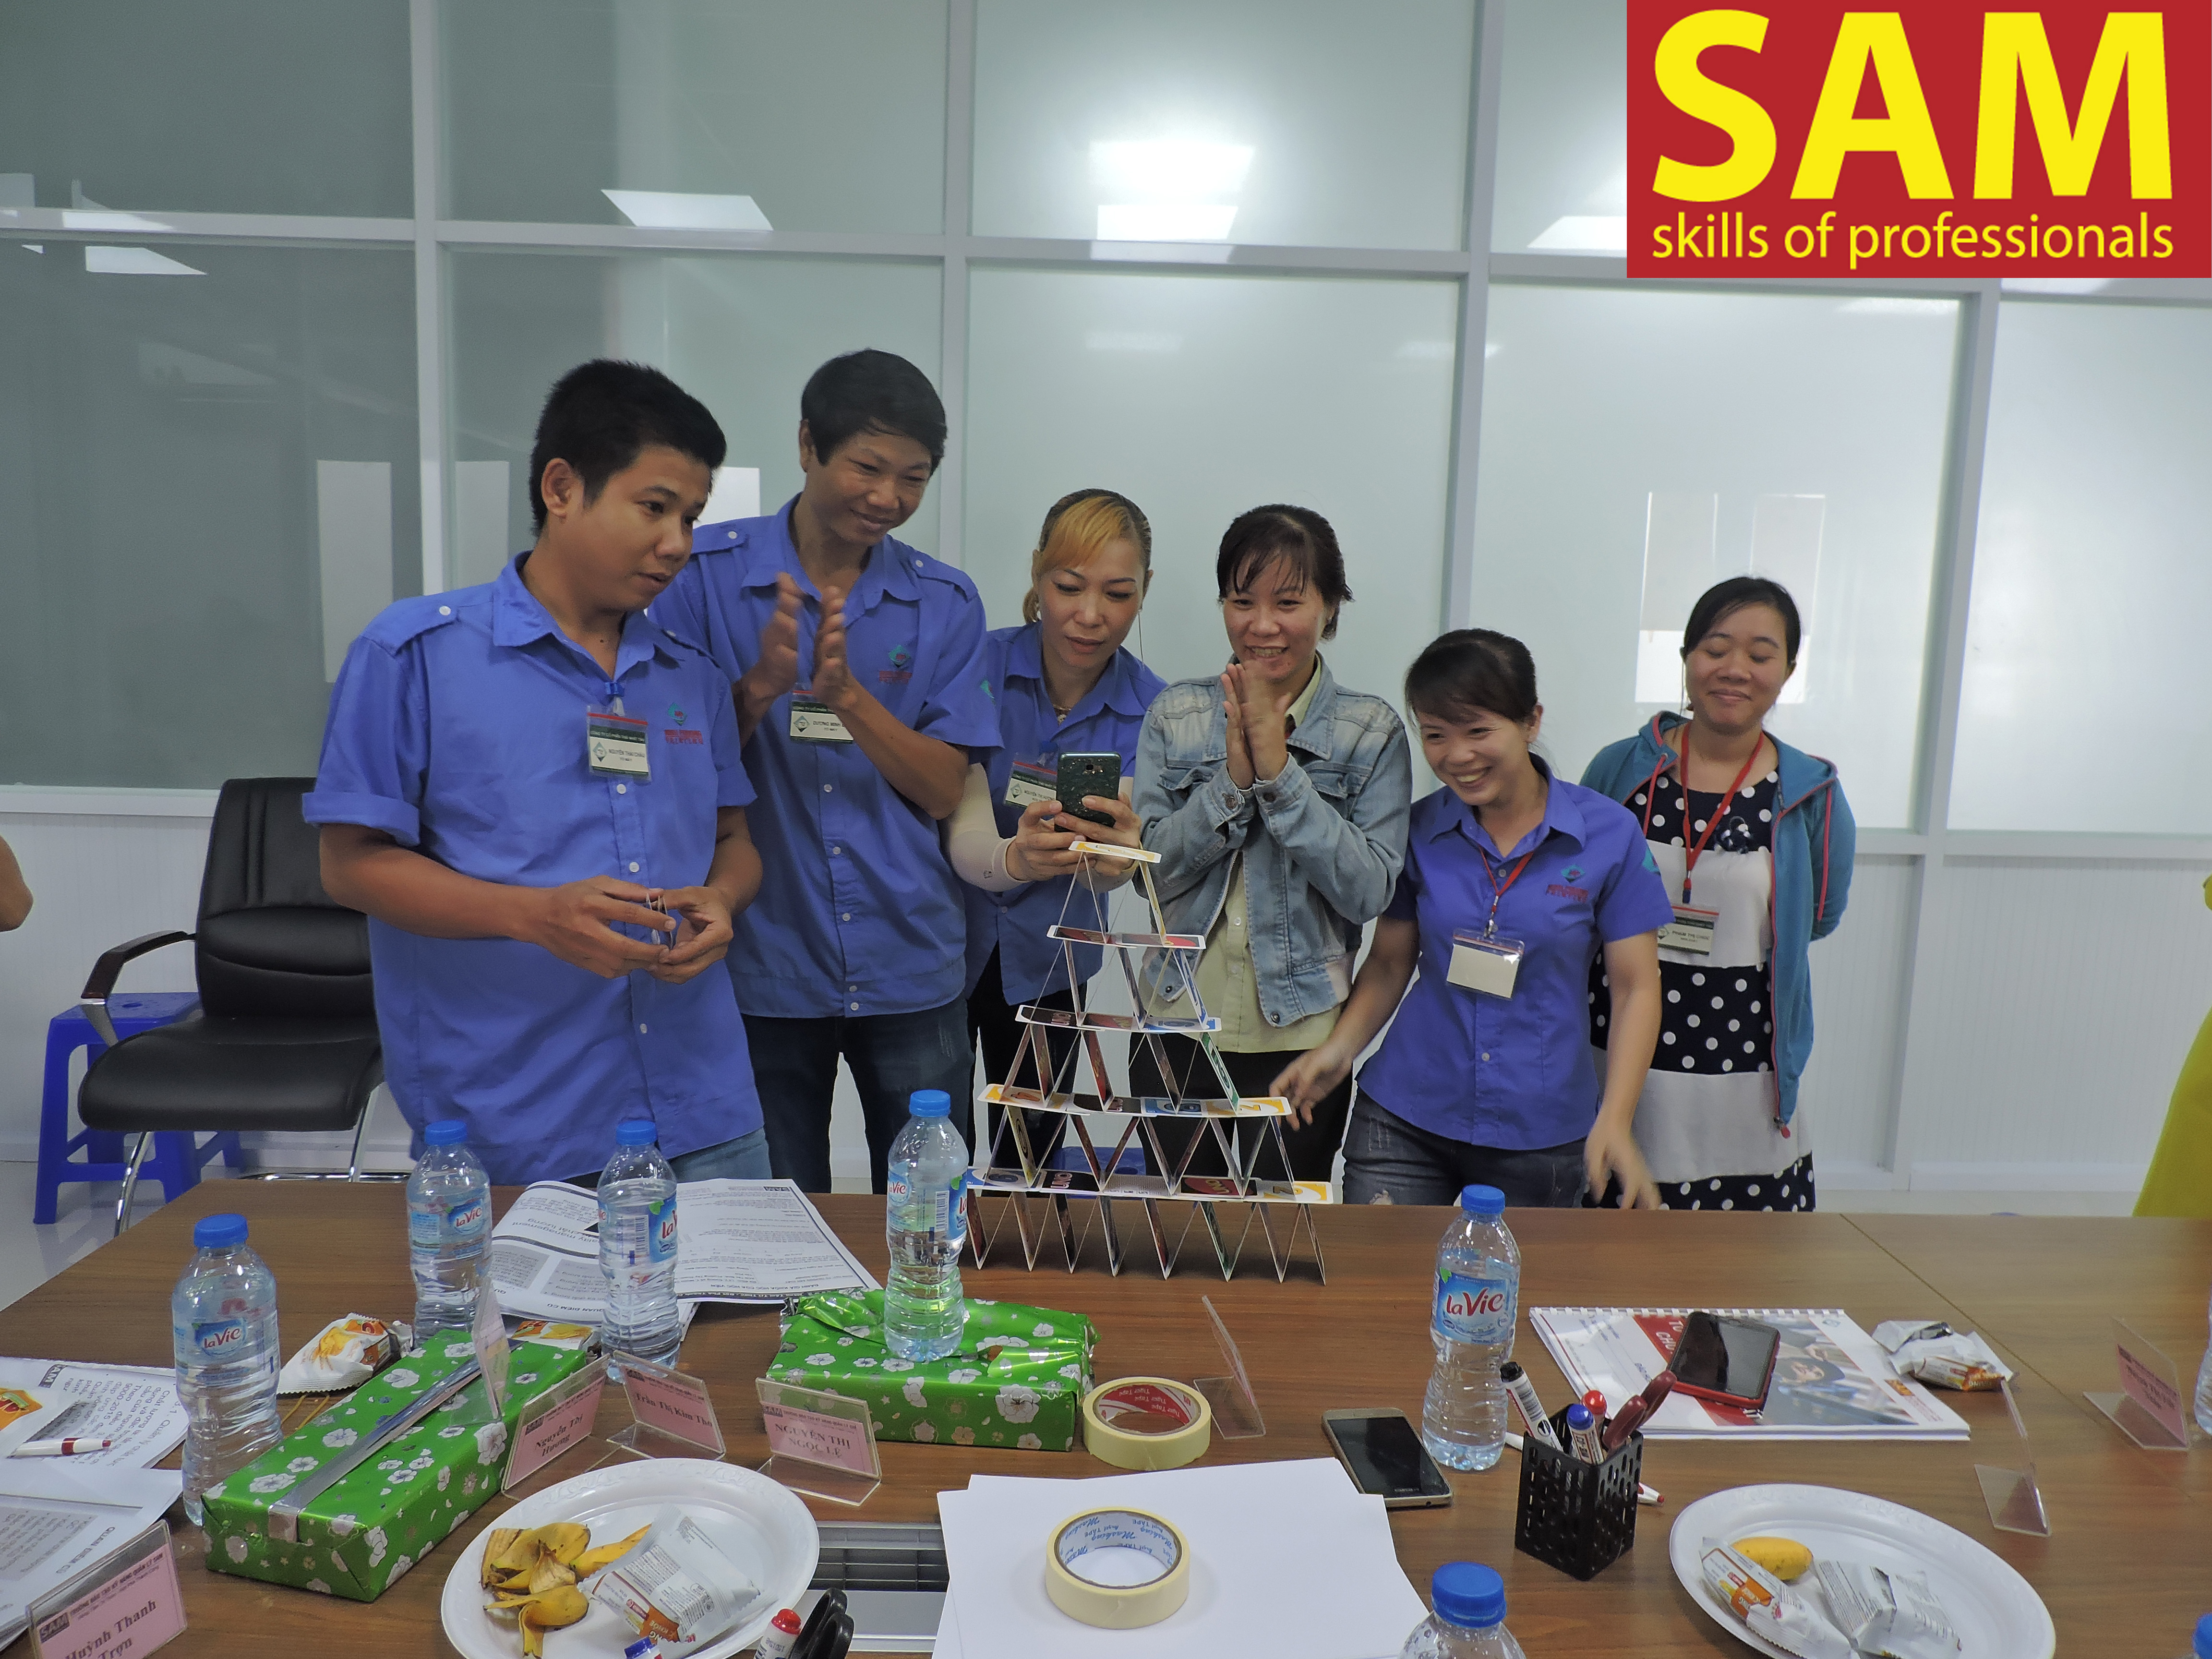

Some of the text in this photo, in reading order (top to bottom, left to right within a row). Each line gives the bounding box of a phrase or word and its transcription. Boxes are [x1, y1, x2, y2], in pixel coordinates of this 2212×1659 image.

[1050, 1172, 1073, 1190] UNO
[674, 1407, 693, 1420] Kim
[829, 1435, 851, 1449] THỊ
[64, 1630, 111, 1659] Huỳnh
[114, 1600, 157, 1634] Thanh
